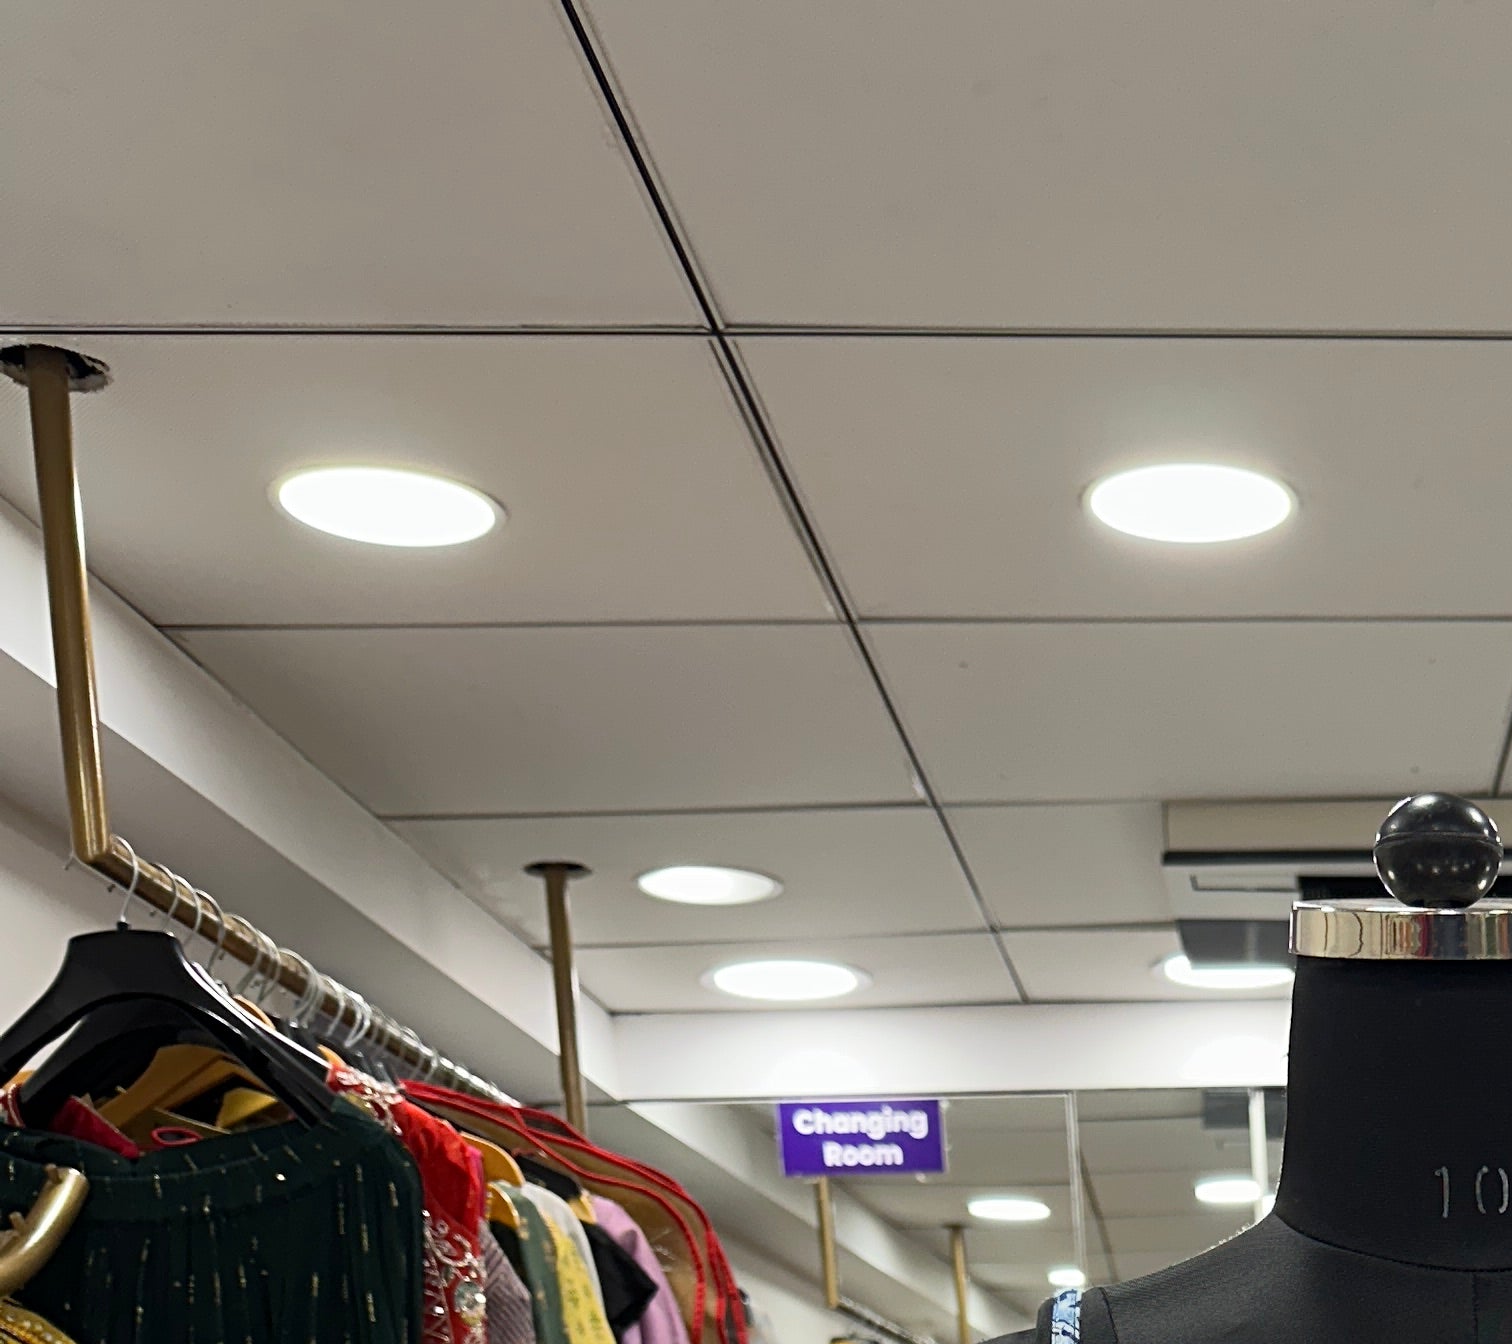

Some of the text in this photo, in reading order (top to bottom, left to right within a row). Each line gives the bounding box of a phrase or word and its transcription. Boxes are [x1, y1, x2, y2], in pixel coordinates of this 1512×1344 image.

[792, 1104, 929, 1140] Changing
[822, 1141, 903, 1167] Room
[1434, 1165, 1509, 1218] 10
